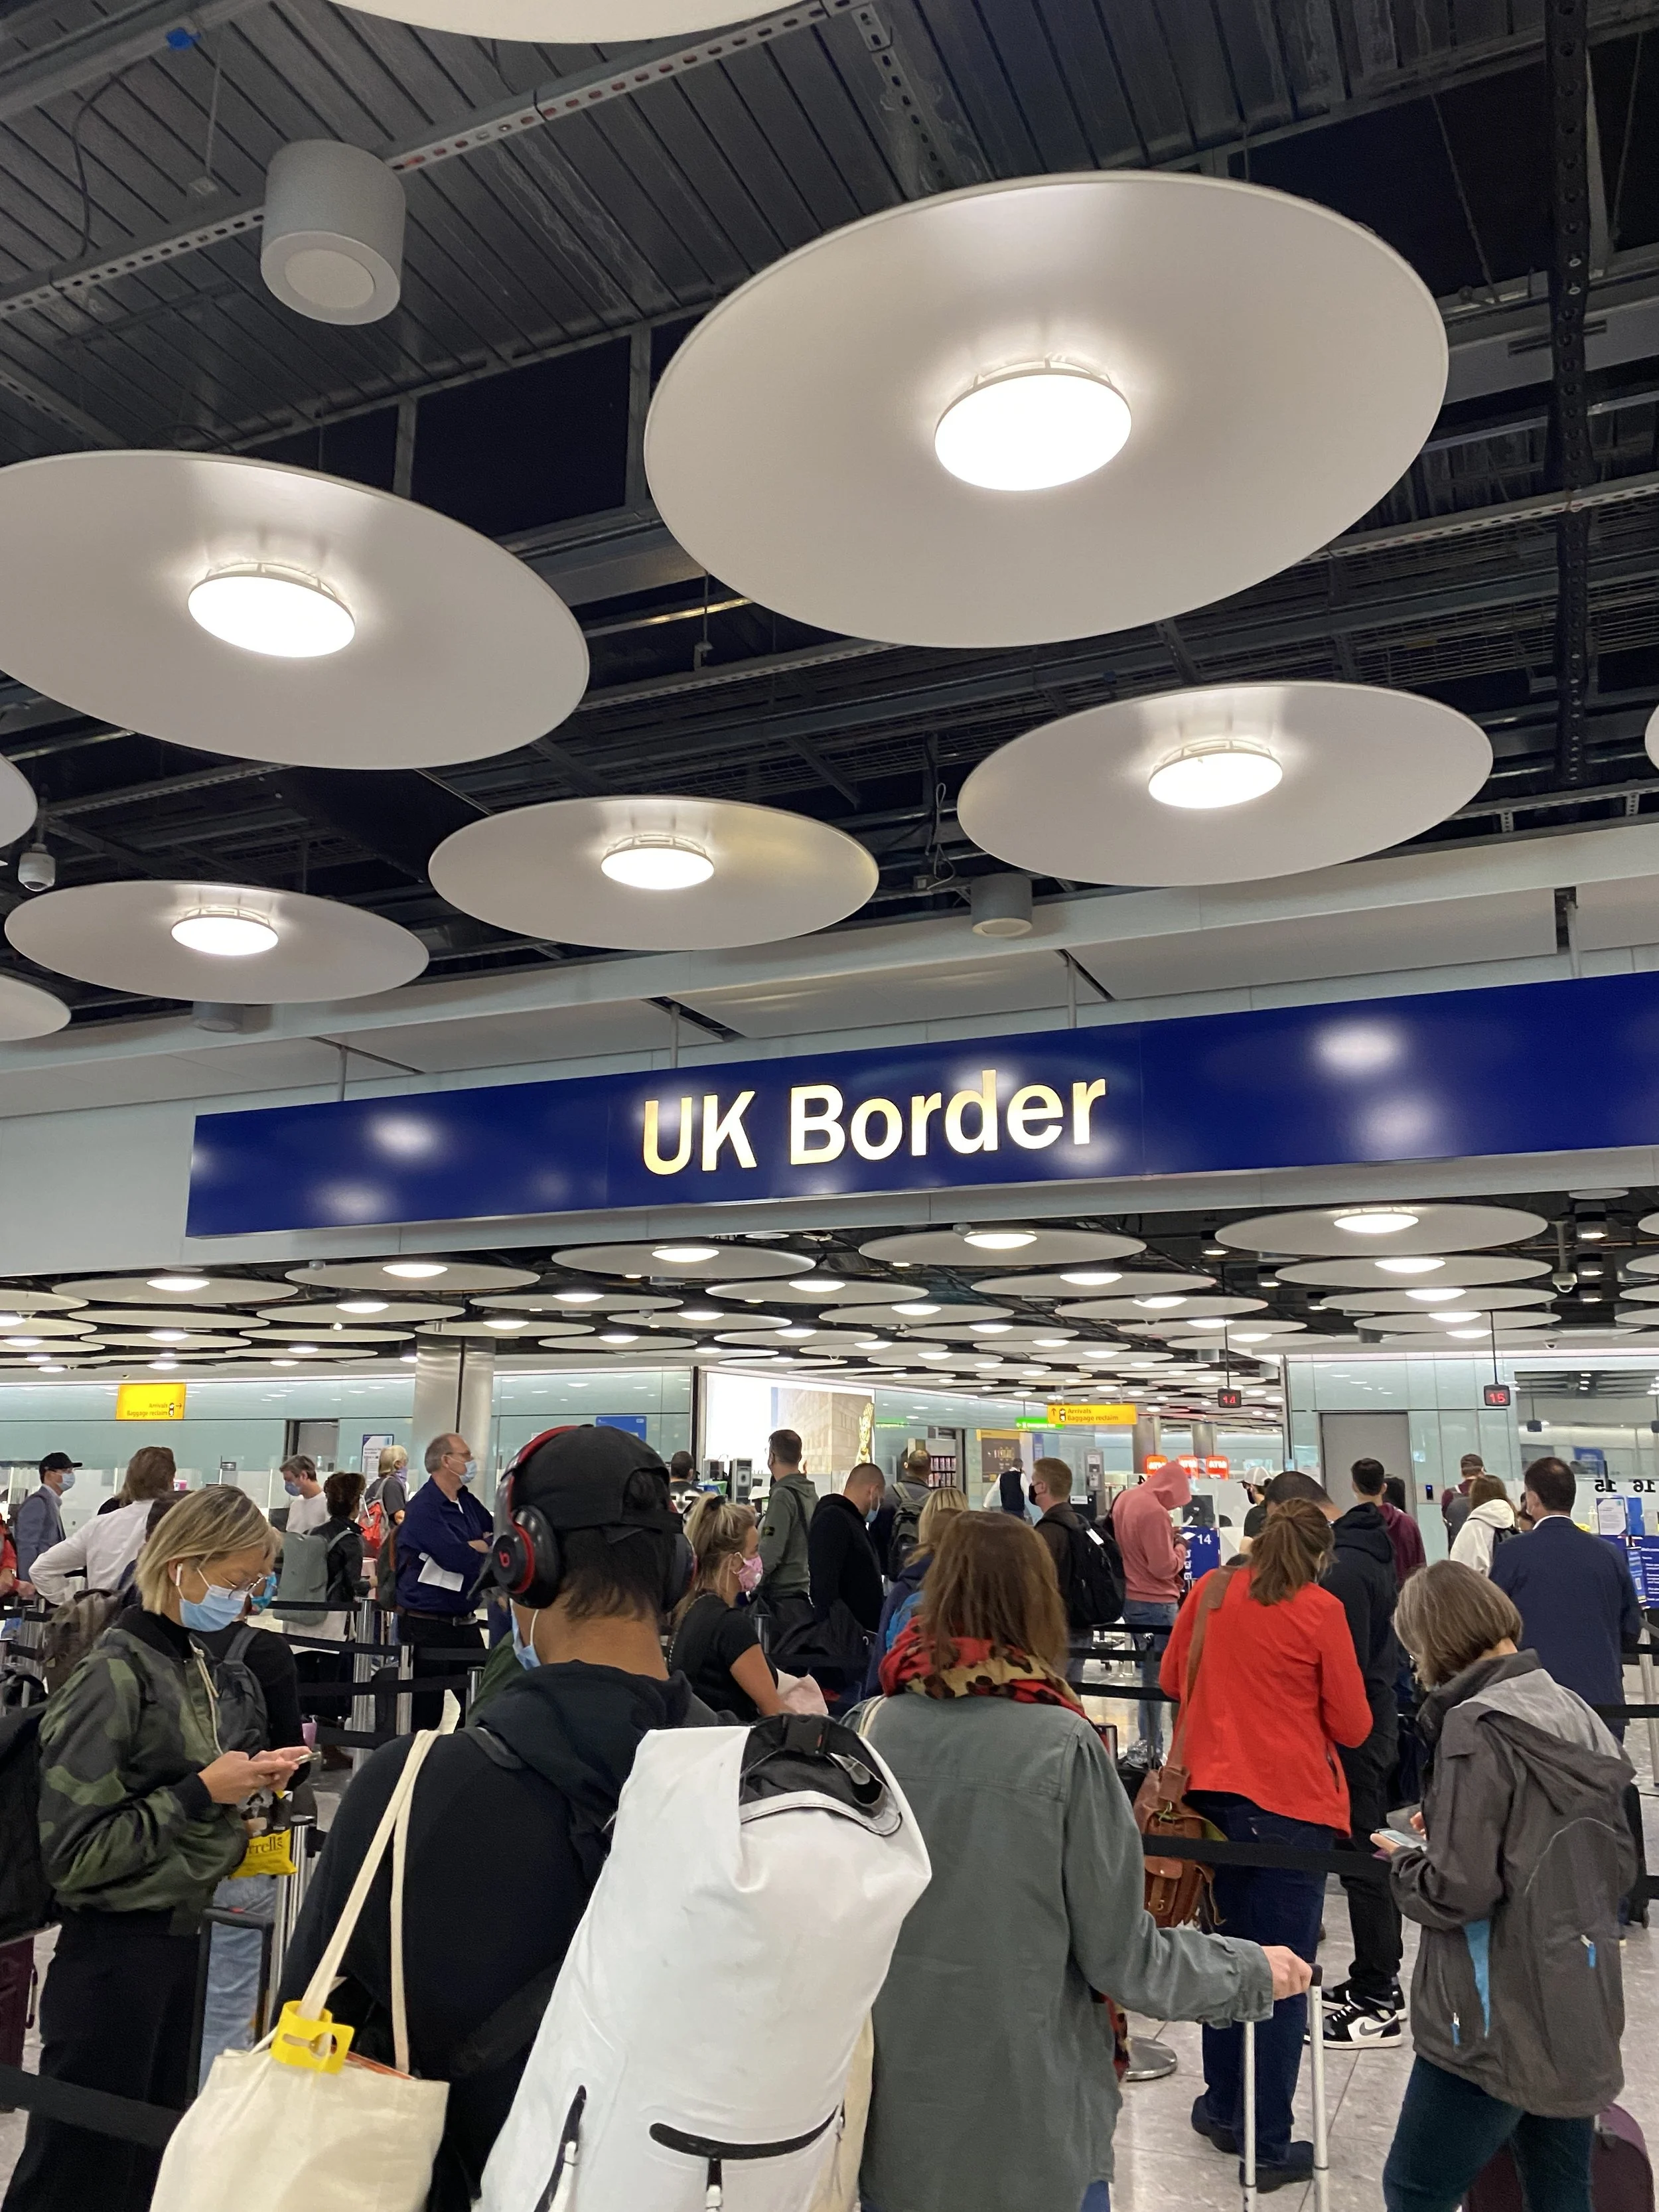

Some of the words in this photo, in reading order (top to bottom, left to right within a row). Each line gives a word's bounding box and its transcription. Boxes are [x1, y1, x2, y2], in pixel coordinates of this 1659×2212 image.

[644, 1090, 757, 1175] UK
[790, 1069, 1106, 1165] Border
[1490, 1393, 1506, 1403] 15
[1197, 1534, 1212, 1545] 14
[248, 1835, 283, 1854] rrells
